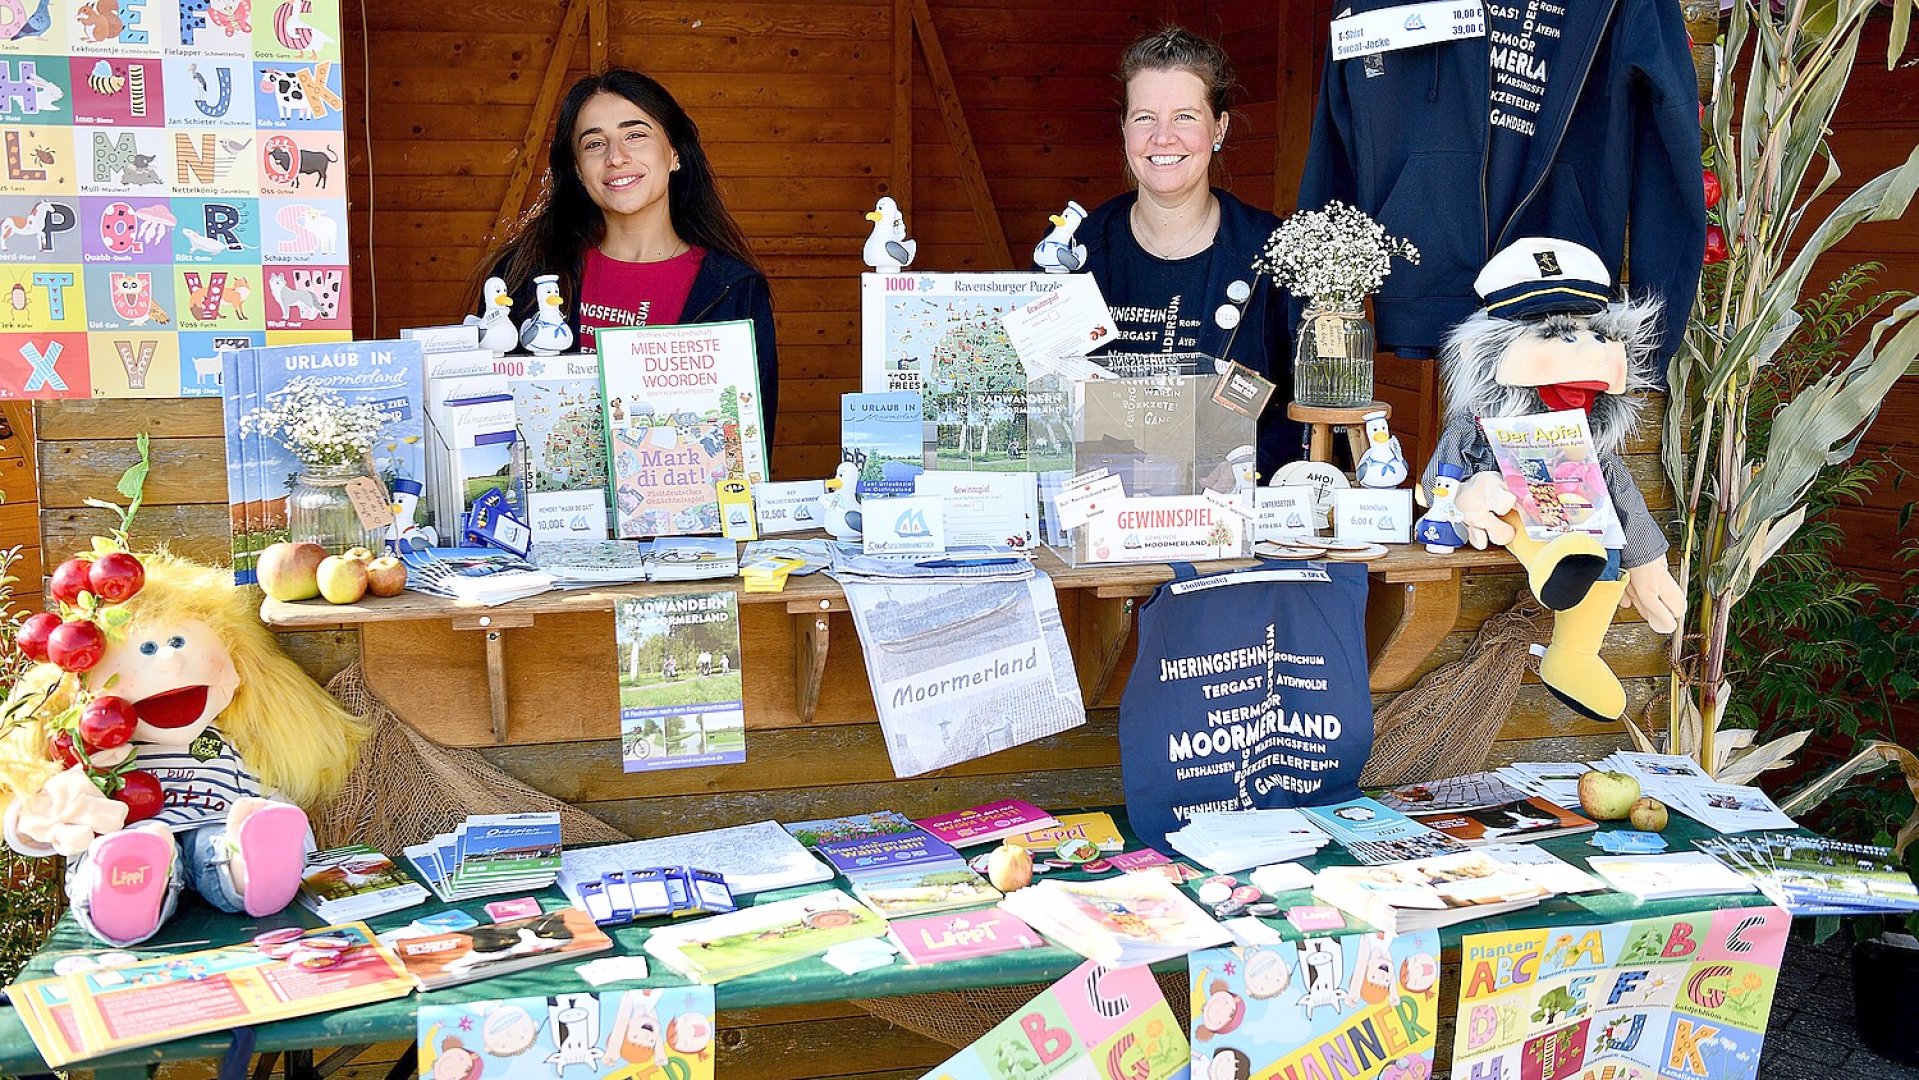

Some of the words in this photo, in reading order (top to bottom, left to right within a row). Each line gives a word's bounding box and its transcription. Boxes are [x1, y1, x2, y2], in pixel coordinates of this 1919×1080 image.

[885, 277, 914, 291] 1000
[955, 280, 1027, 294] Ravensburger
[632, 343, 667, 355] MIEN
[671, 339, 720, 353] EERSTE
[285, 352, 359, 371] URLAUB
[370, 351, 392, 366] IN
[645, 355, 714, 371] DUSEND
[642, 372, 717, 388] WOORDEN
[862, 404, 899, 412] URLAUB
[1496, 429, 1529, 442] Der
[1535, 424, 1583, 442] Apfel
[641, 449, 700, 467] Mark
[637, 469, 656, 487] di
[663, 467, 706, 486] dat!
[1117, 508, 1214, 530] GEWINNSPIEL
[1145, 539, 1208, 548] MOORMERLAND
[624, 598, 728, 615] RADWANDERN
[1160, 644, 1267, 682] JHERINGSFEHN
[891, 647, 1037, 710] Moormerland
[1202, 676, 1263, 699] TERGAST
[1208, 693, 1282, 727] NEERMOOR
[1168, 708, 1342, 762] MOORMERLAND
[1177, 761, 1235, 781] HATSHAUSEN
[1660, 922, 1696, 958] B
[1725, 915, 1766, 953] C
[1471, 940, 1542, 961] Planten-
[1563, 931, 1604, 968] A
[1465, 952, 1538, 998] ABC
[1606, 970, 1650, 1006] F
[1020, 1012, 1072, 1066] B
[1668, 1018, 1722, 1077] K
